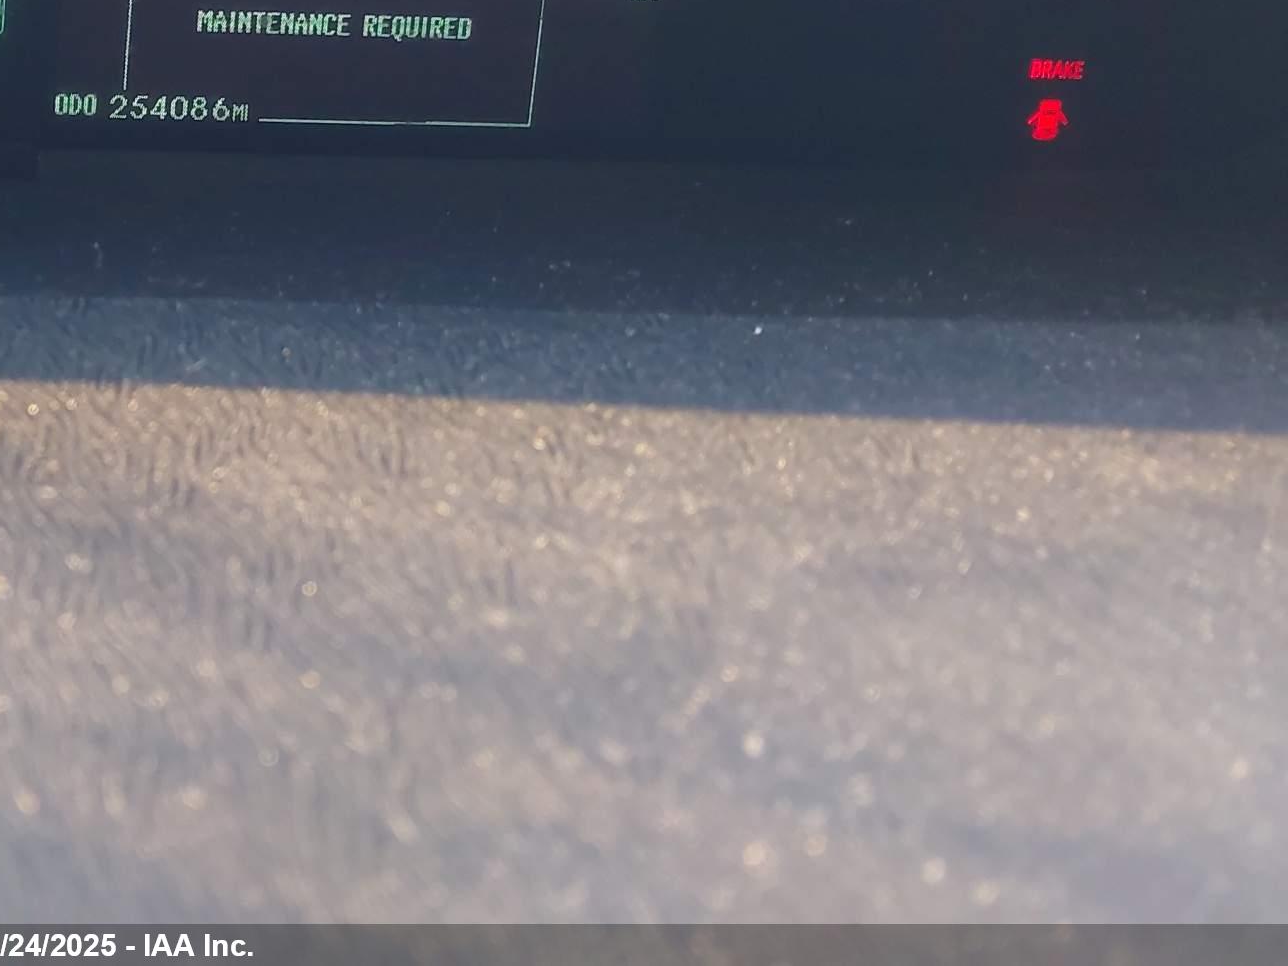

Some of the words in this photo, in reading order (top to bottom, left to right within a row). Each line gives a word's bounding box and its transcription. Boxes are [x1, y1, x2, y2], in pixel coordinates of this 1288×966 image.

[196, 10, 350, 37] MAINTENANCE
[362, 15, 472, 40] REQUIRED
[1028, 58, 1085, 80] BRAKE
[54, 94, 97, 116] ODO
